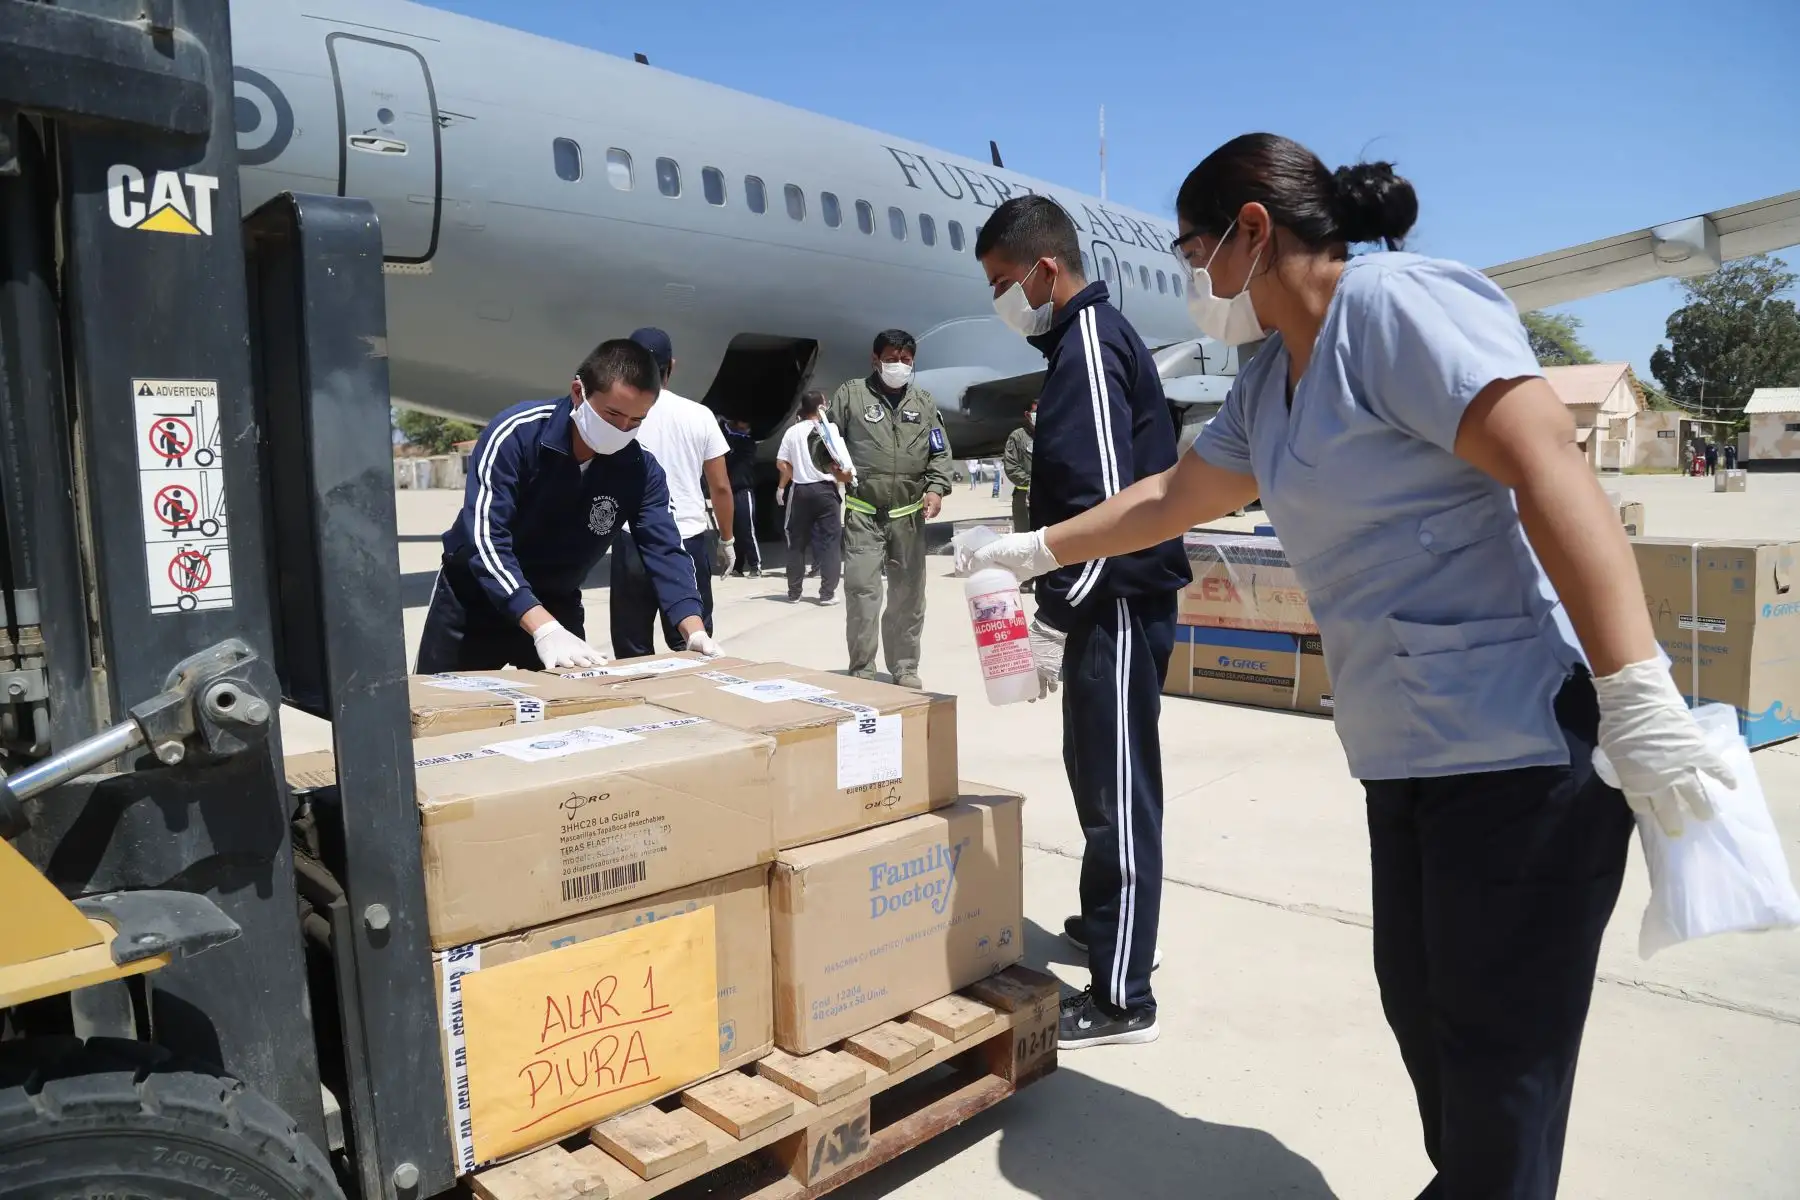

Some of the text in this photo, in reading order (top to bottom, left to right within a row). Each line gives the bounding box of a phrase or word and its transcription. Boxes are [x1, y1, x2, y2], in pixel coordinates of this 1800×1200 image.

[107, 164, 219, 236] CAT
[156, 385, 216, 398] ADVERTENCIA
[975, 620, 1007, 634] ALCOHOL
[1232, 659, 1269, 671] GREE
[859, 718, 876, 734] FAP
[560, 809, 640, 834] 3HHC28 La Guaira
[560, 829, 596, 844] Mascarillas
[628, 815, 665, 828] desechables
[562, 868, 571, 876] 20
[869, 843, 962, 914] Family
[870, 882, 945, 919] Doctor
[718, 986, 737, 998] HITE
[541, 975, 621, 1043] ALAR
[518, 1030, 652, 1108] PIURA
